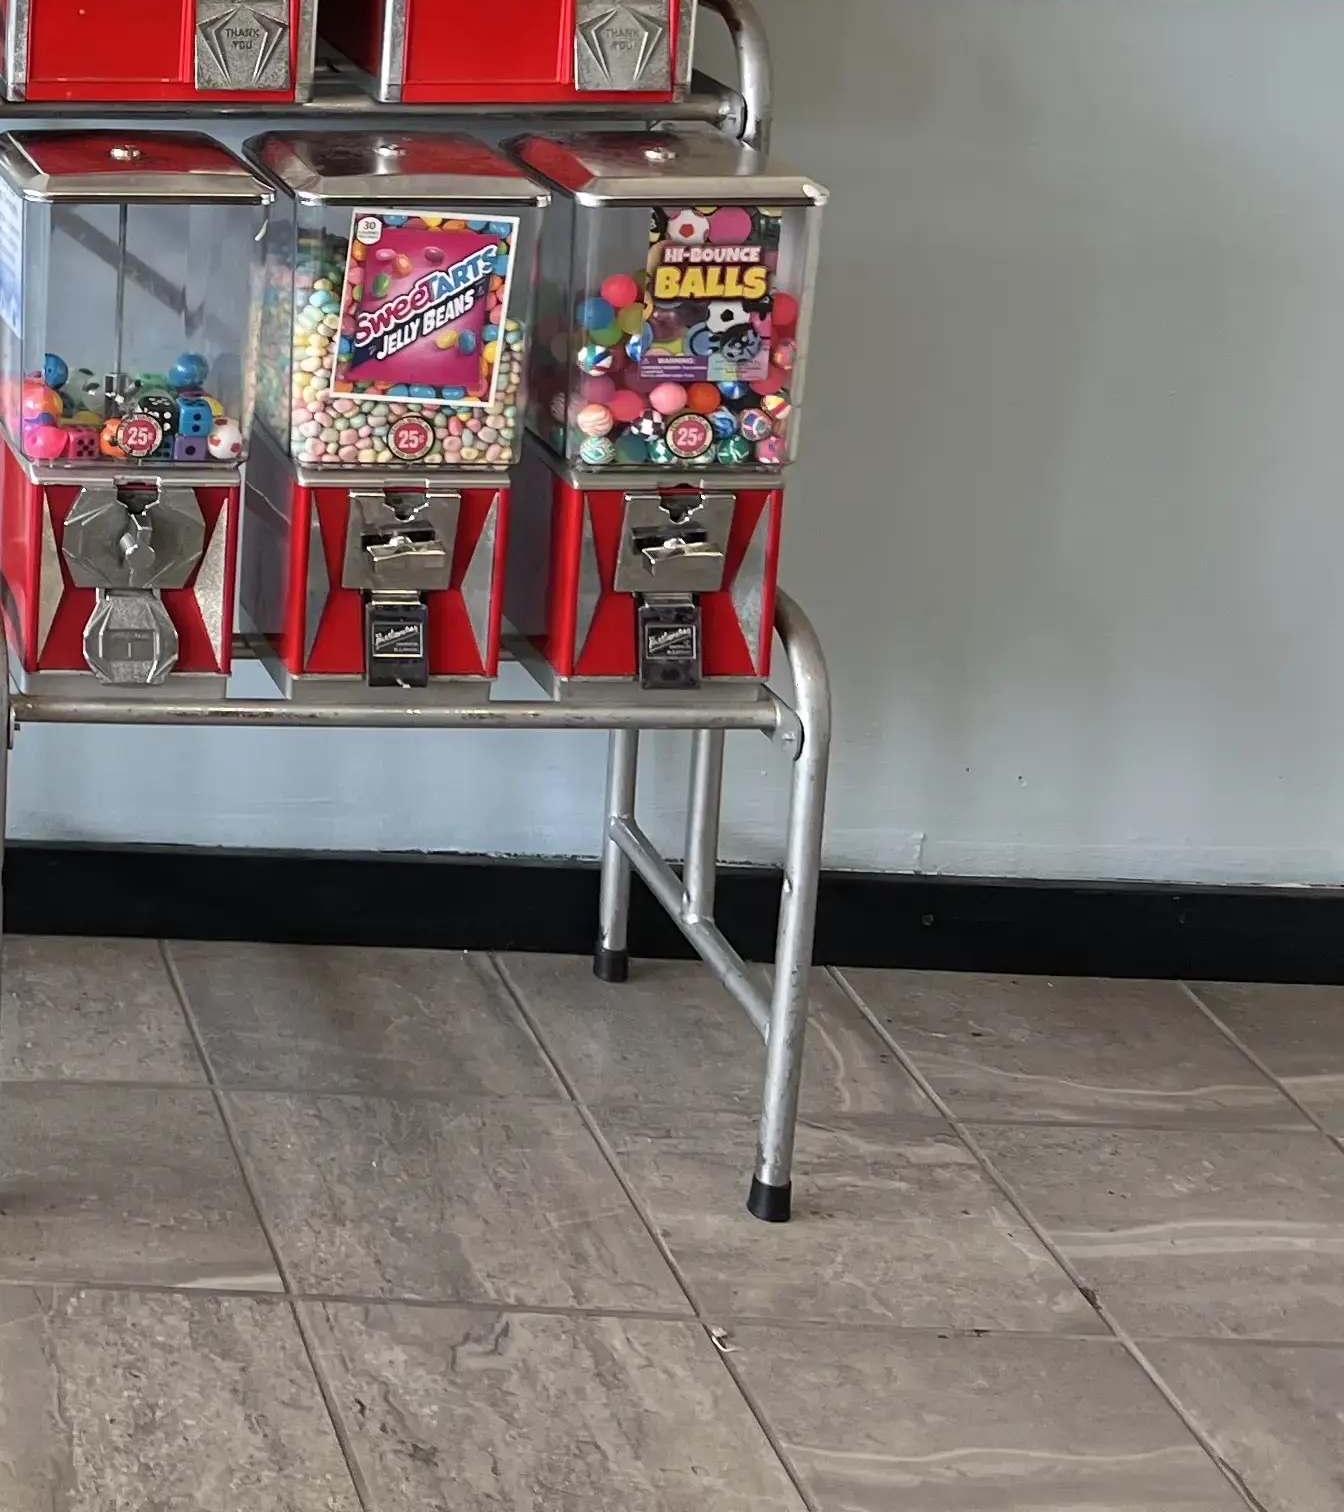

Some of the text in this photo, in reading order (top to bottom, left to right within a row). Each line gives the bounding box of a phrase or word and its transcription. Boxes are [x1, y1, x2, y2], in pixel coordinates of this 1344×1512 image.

[225, 28, 261, 38] THANK
[232, 40, 253, 50] YOU
[363, 220, 377, 230] 30
[664, 246, 761, 263] HI-BOUNCE
[655, 266, 767, 299] BALLS
[377, 289, 475, 360] JELLY BEANS
[127, 426, 154, 445] 25¢
[398, 430, 425, 449] 25¢
[676, 427, 705, 447] 25¢
